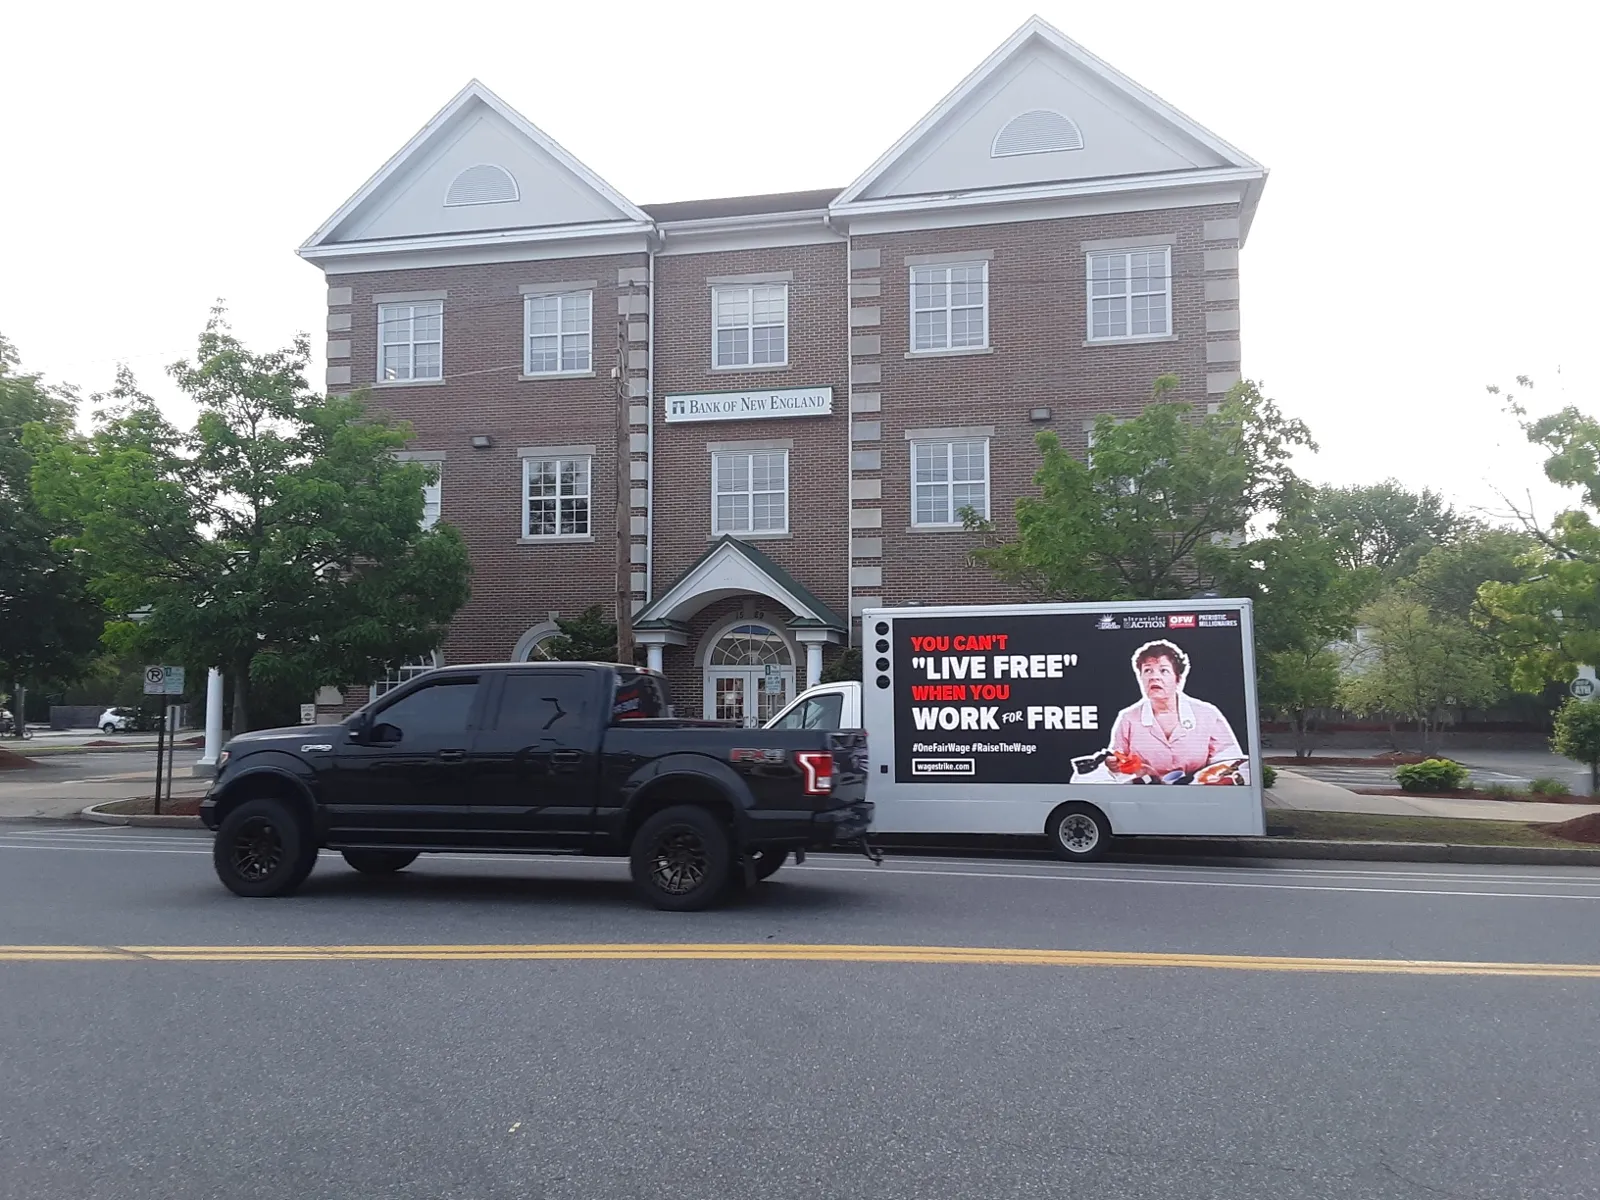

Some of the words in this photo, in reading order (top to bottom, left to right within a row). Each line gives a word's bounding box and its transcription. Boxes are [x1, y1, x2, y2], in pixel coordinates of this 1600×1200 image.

[690, 400, 720, 414] BANK
[723, 401, 737, 413] OF
[741, 397, 767, 411] NEW
[770, 395, 825, 410] ENGLAND
[1131, 620, 1166, 629] ACTION
[1169, 615, 1194, 624] OFW
[911, 636, 949, 652] YOU
[953, 634, 1008, 651] CAN'T
[912, 655, 987, 680] "LIVE
[993, 654, 1078, 679] FREE"
[912, 684, 966, 701] WHEN
[969, 684, 1010, 701] YOU
[912, 707, 1000, 731] WORK
[1002, 711, 1024, 724] FOR
[1026, 706, 1099, 730] FREE
[912, 742, 971, 755] #OneFairWage
[971, 742, 1037, 755] #RaiseTheWage
[917, 762, 970, 772] wagestrike.com
